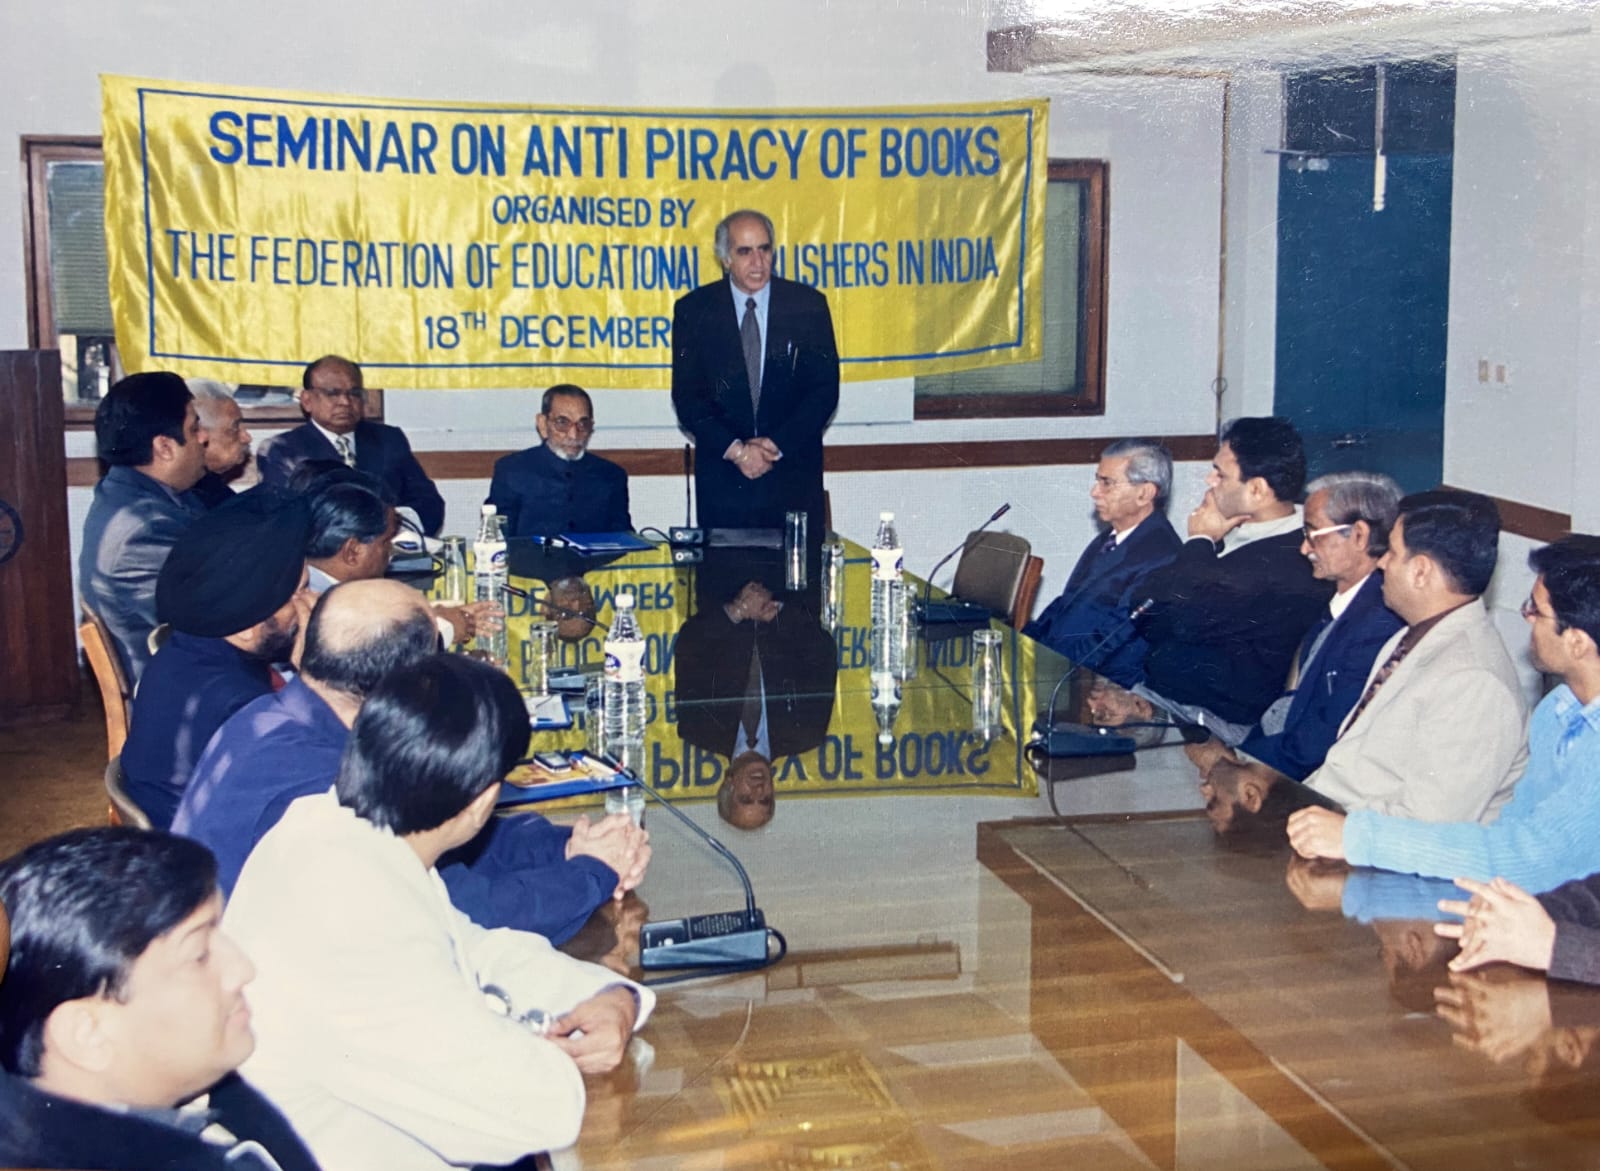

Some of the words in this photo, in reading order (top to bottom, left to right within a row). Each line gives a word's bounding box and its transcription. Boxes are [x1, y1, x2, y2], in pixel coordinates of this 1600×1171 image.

[209, 110, 438, 174] SEMINAR
[451, 123, 506, 176] ON
[522, 125, 628, 178] ANTI
[646, 127, 808, 180] PIRACY
[819, 127, 866, 180] OF
[880, 126, 1000, 178] BOOKS
[493, 195, 651, 227] ORGANISED
[660, 198, 695, 228] BY
[166, 229, 236, 280] THE
[250, 234, 454, 288] FEDERATION
[466, 243, 500, 289] OF
[897, 240, 924, 285] IN
[931, 236, 999, 284] INDIA
[424, 312, 486, 349] 18TH
[500, 314, 671, 349] DECEMBER
